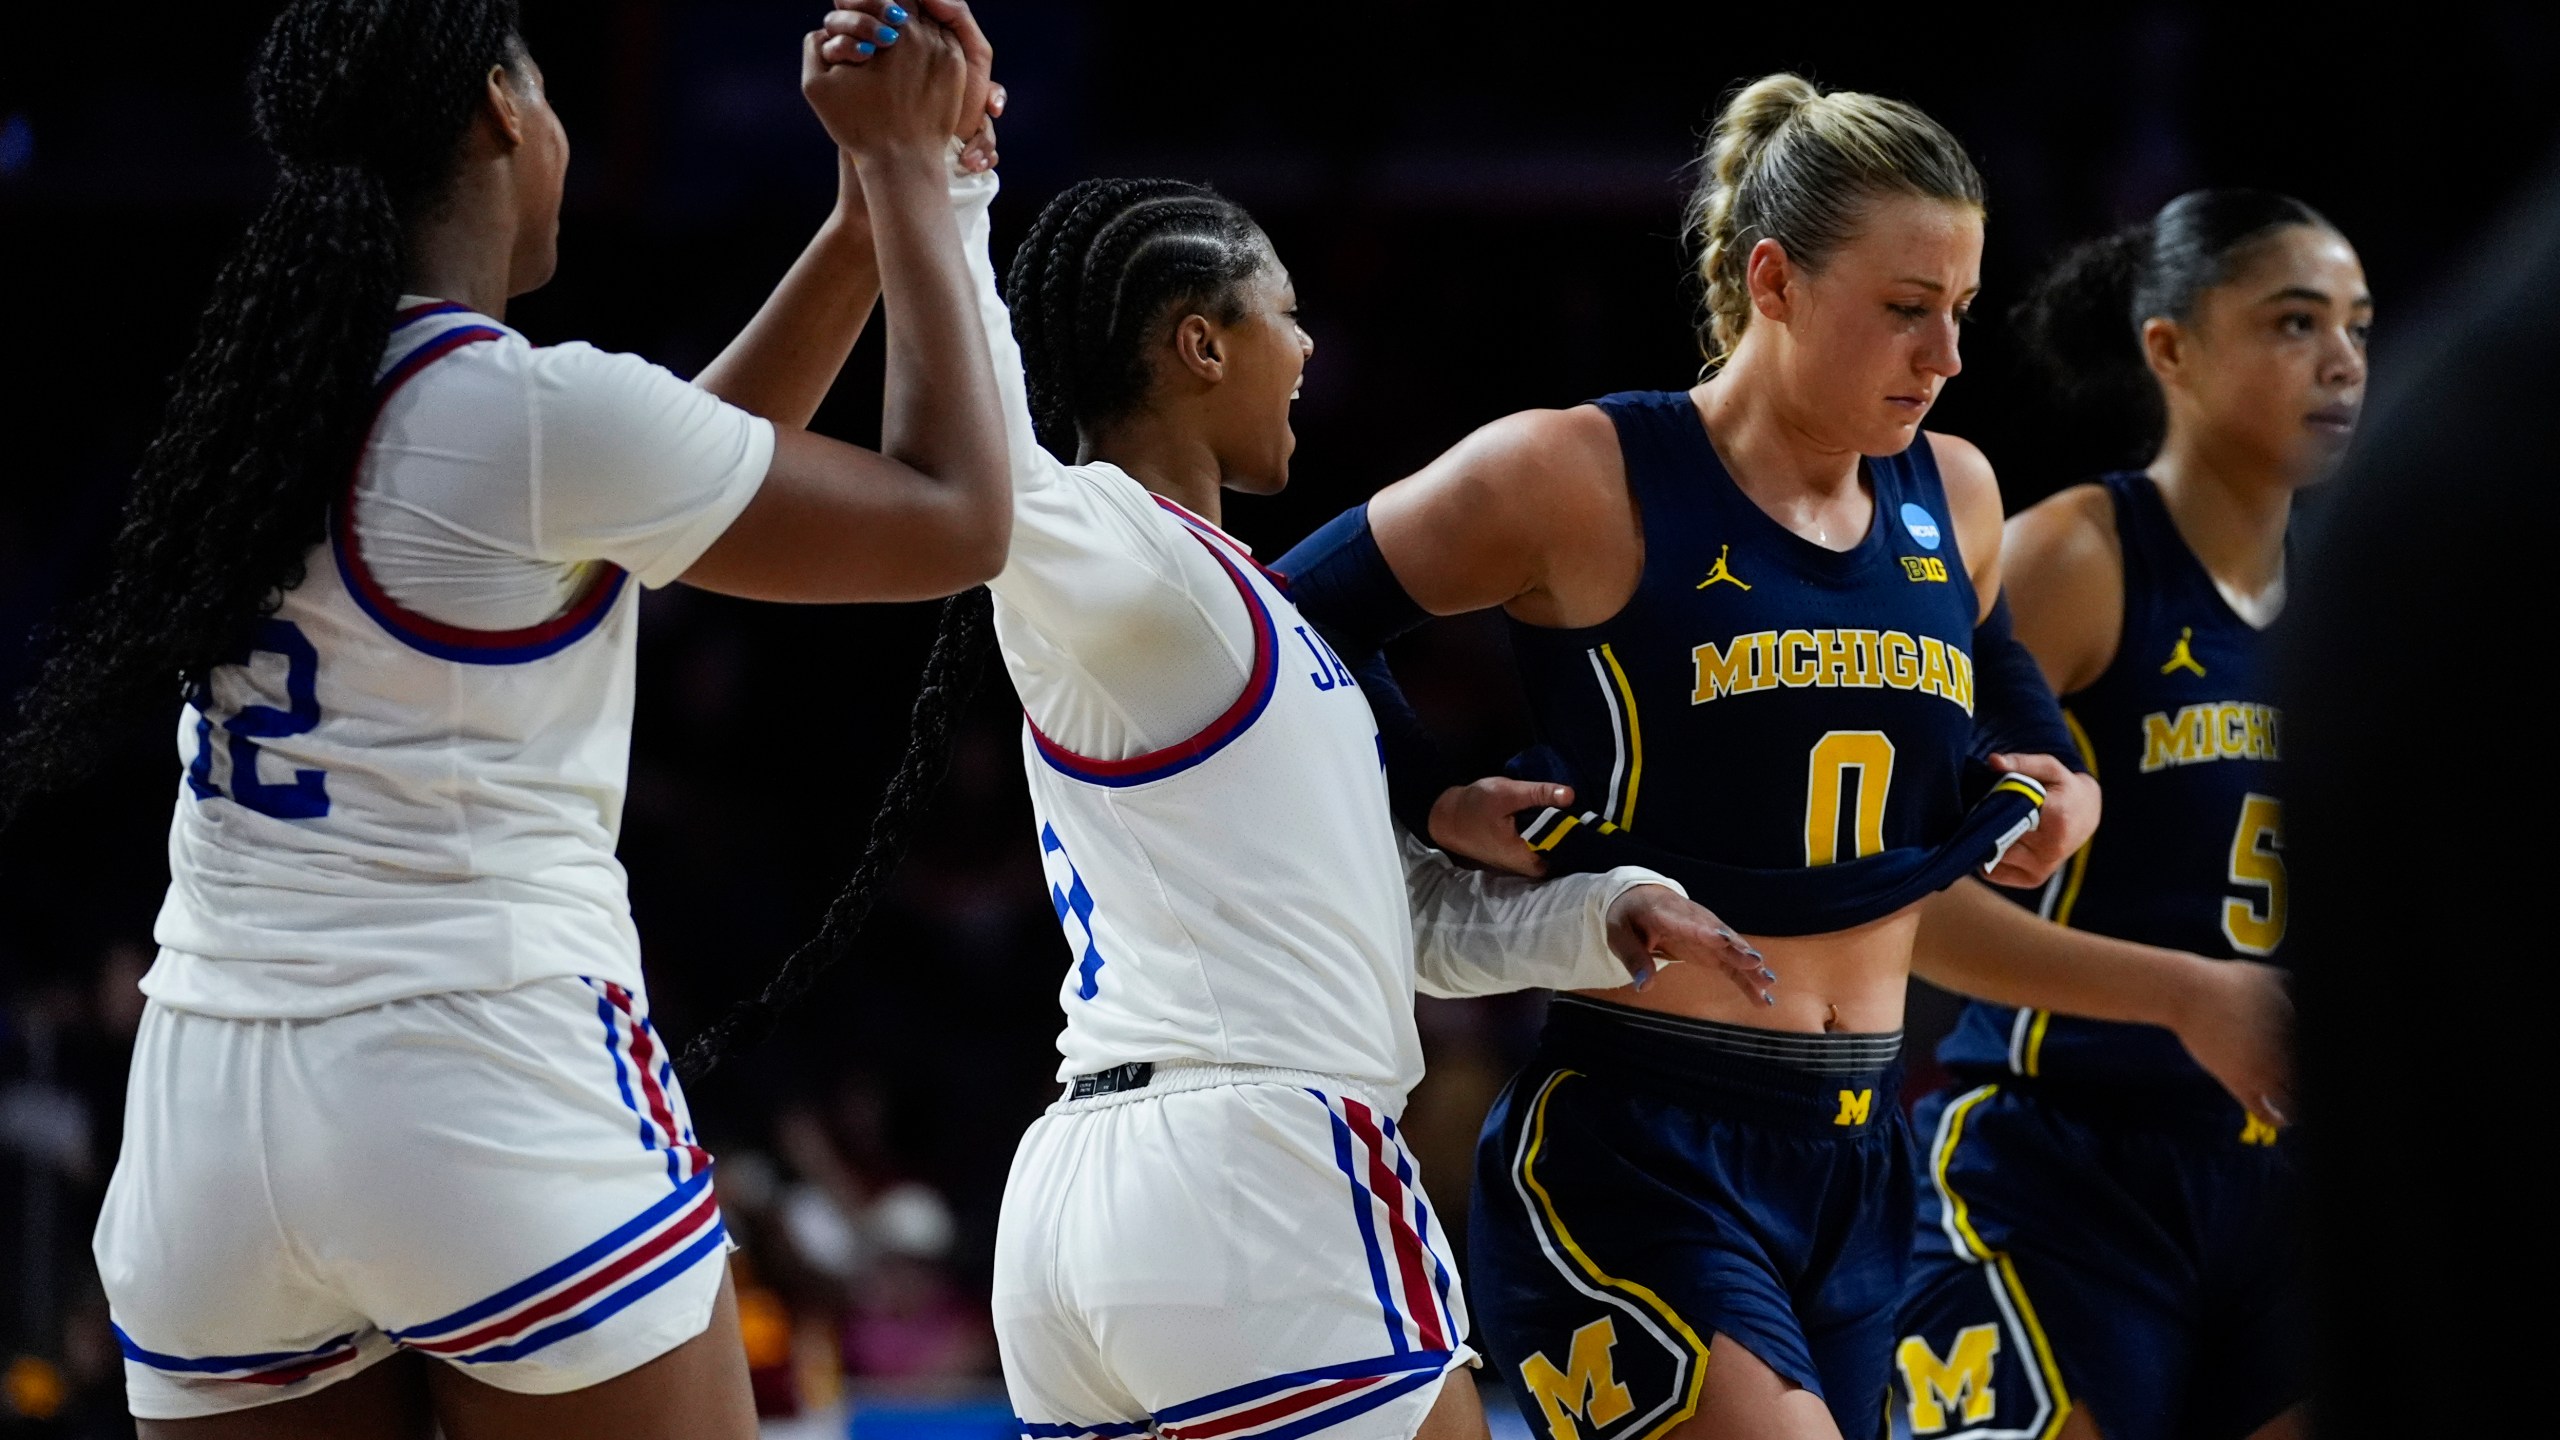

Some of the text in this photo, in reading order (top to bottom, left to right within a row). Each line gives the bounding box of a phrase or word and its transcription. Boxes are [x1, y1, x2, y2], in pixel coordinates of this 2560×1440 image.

[1691, 628, 1974, 718] MICHIGAN
[2138, 700, 2285, 774] MICH
[1804, 730, 1896, 868] 0
[2220, 790, 2290, 958] 5
[1833, 1088, 1873, 1126] M
[1518, 1313, 1637, 1440] M
[1895, 1321, 2001, 1435] M
